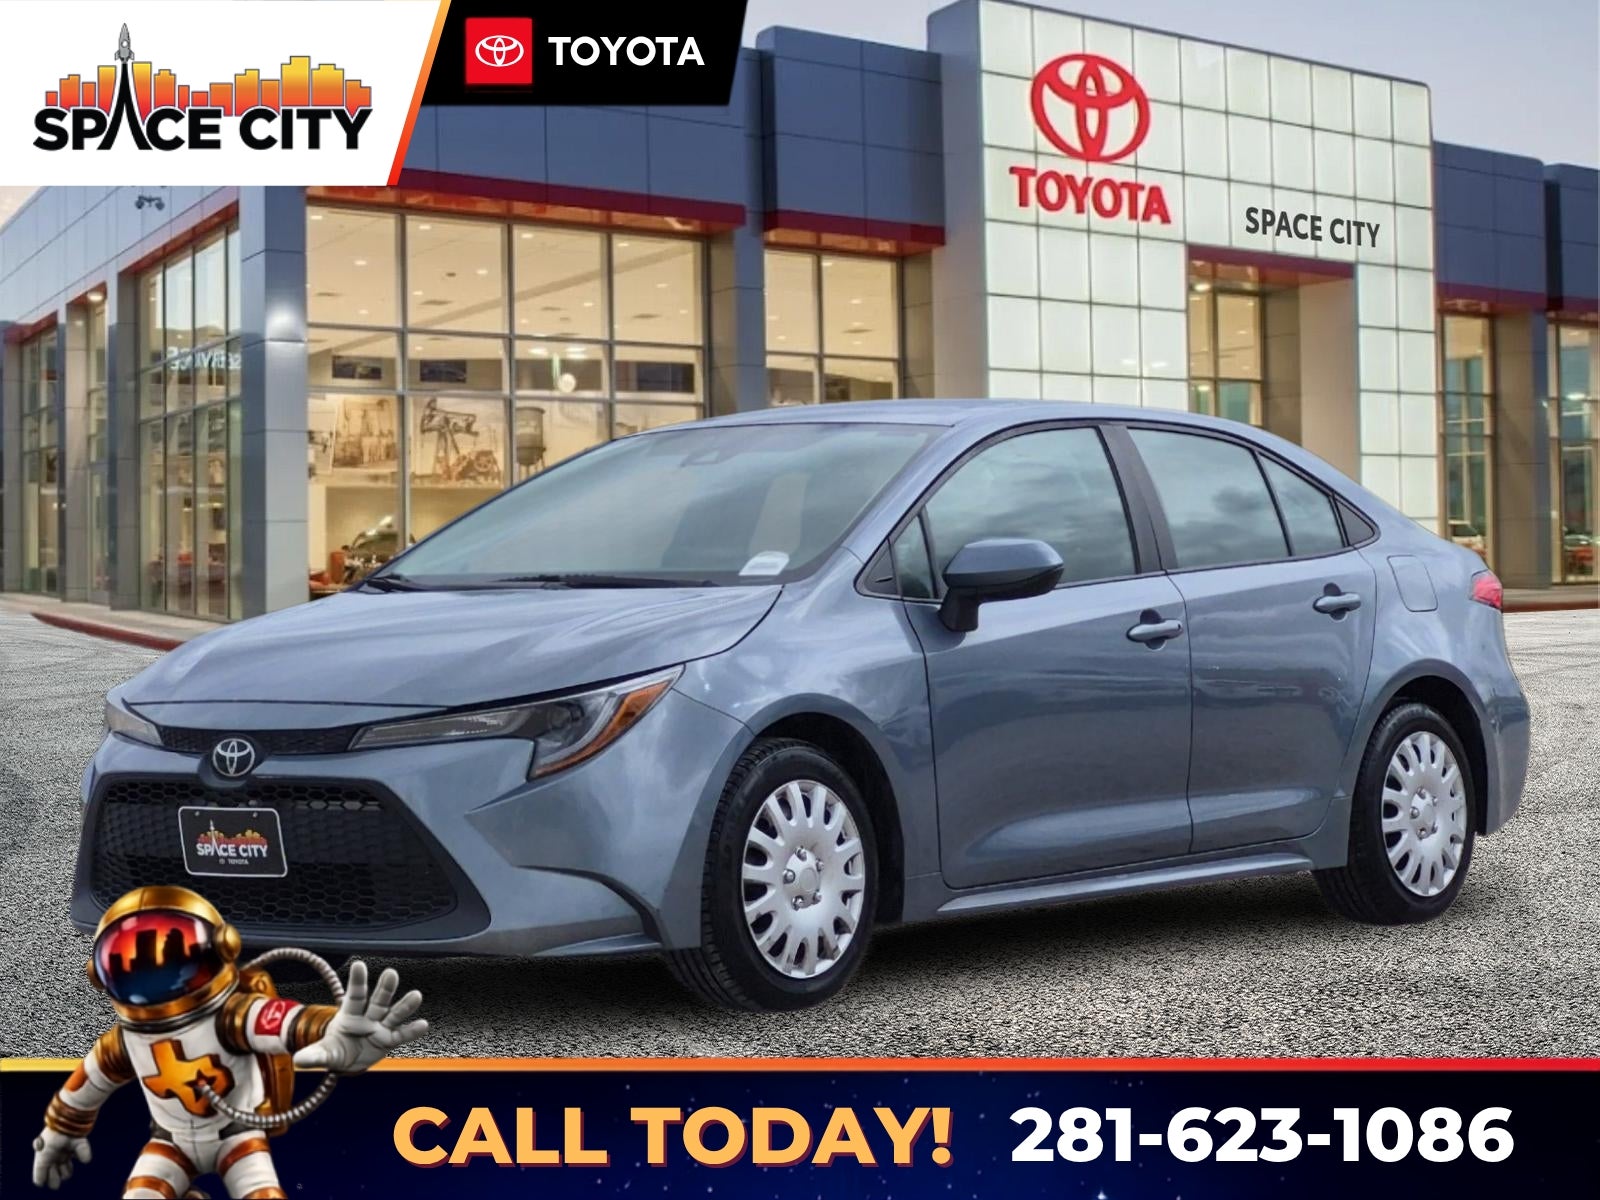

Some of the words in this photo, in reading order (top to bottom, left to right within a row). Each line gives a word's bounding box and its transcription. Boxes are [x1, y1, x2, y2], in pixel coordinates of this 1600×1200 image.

[1010, 165, 1171, 224] TOYOTA
[1245, 206, 1323, 242] SPACE
[1329, 217, 1381, 248] CITY
[196, 842, 237, 856] SPACE
[238, 844, 268, 857] CITY
